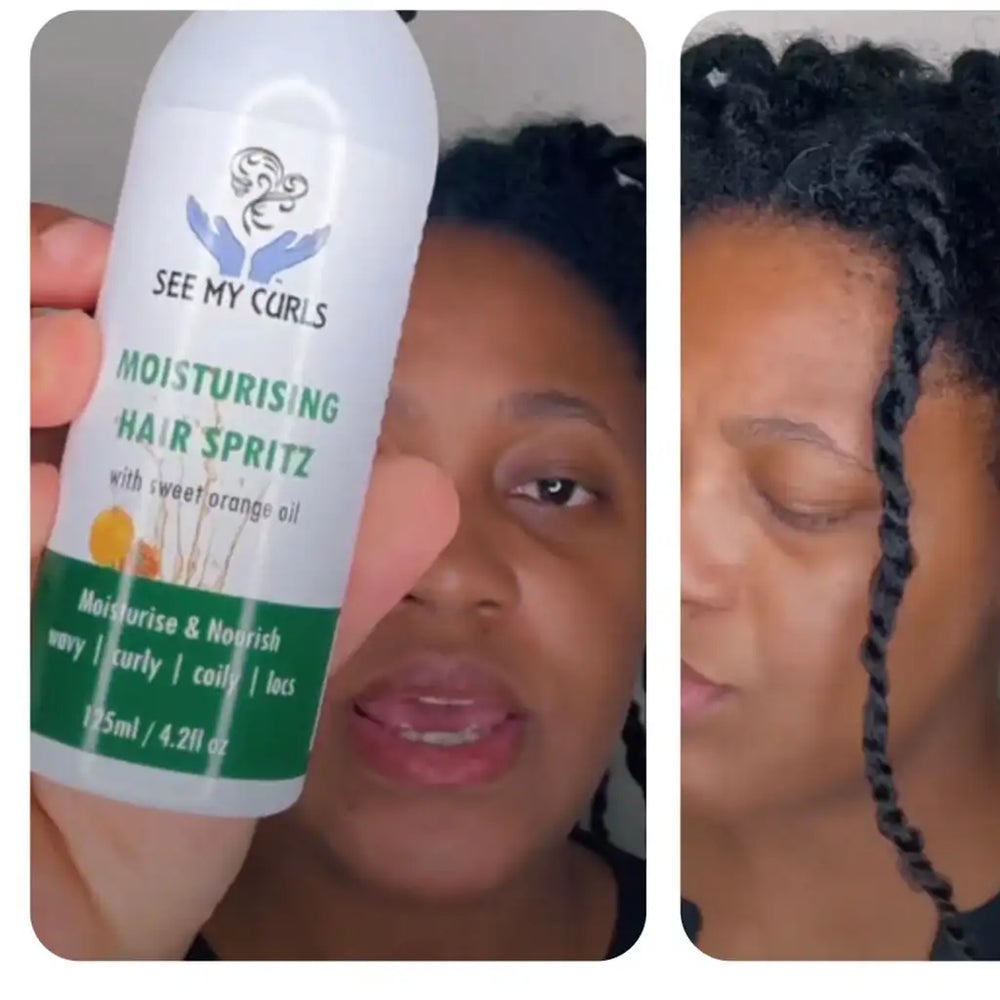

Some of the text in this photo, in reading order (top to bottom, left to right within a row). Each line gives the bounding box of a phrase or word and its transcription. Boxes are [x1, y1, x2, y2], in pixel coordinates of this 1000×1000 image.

[153, 269, 328, 330] SEE MY CURLS
[116, 349, 341, 424] MOISTURISING
[117, 409, 316, 479] HAIR SPRITZ
[109, 467, 301, 525] with sweet orange oil
[77, 587, 281, 653] Moisturise & Nourish
[48, 628, 87, 662] wavy
[112, 647, 163, 683] curly
[193, 664, 241, 696] coily
[265, 670, 296, 697] locs
[82, 705, 141, 741] 125ml
[159, 723, 205, 752] 4.2fl
[207, 737, 230, 757] oz
